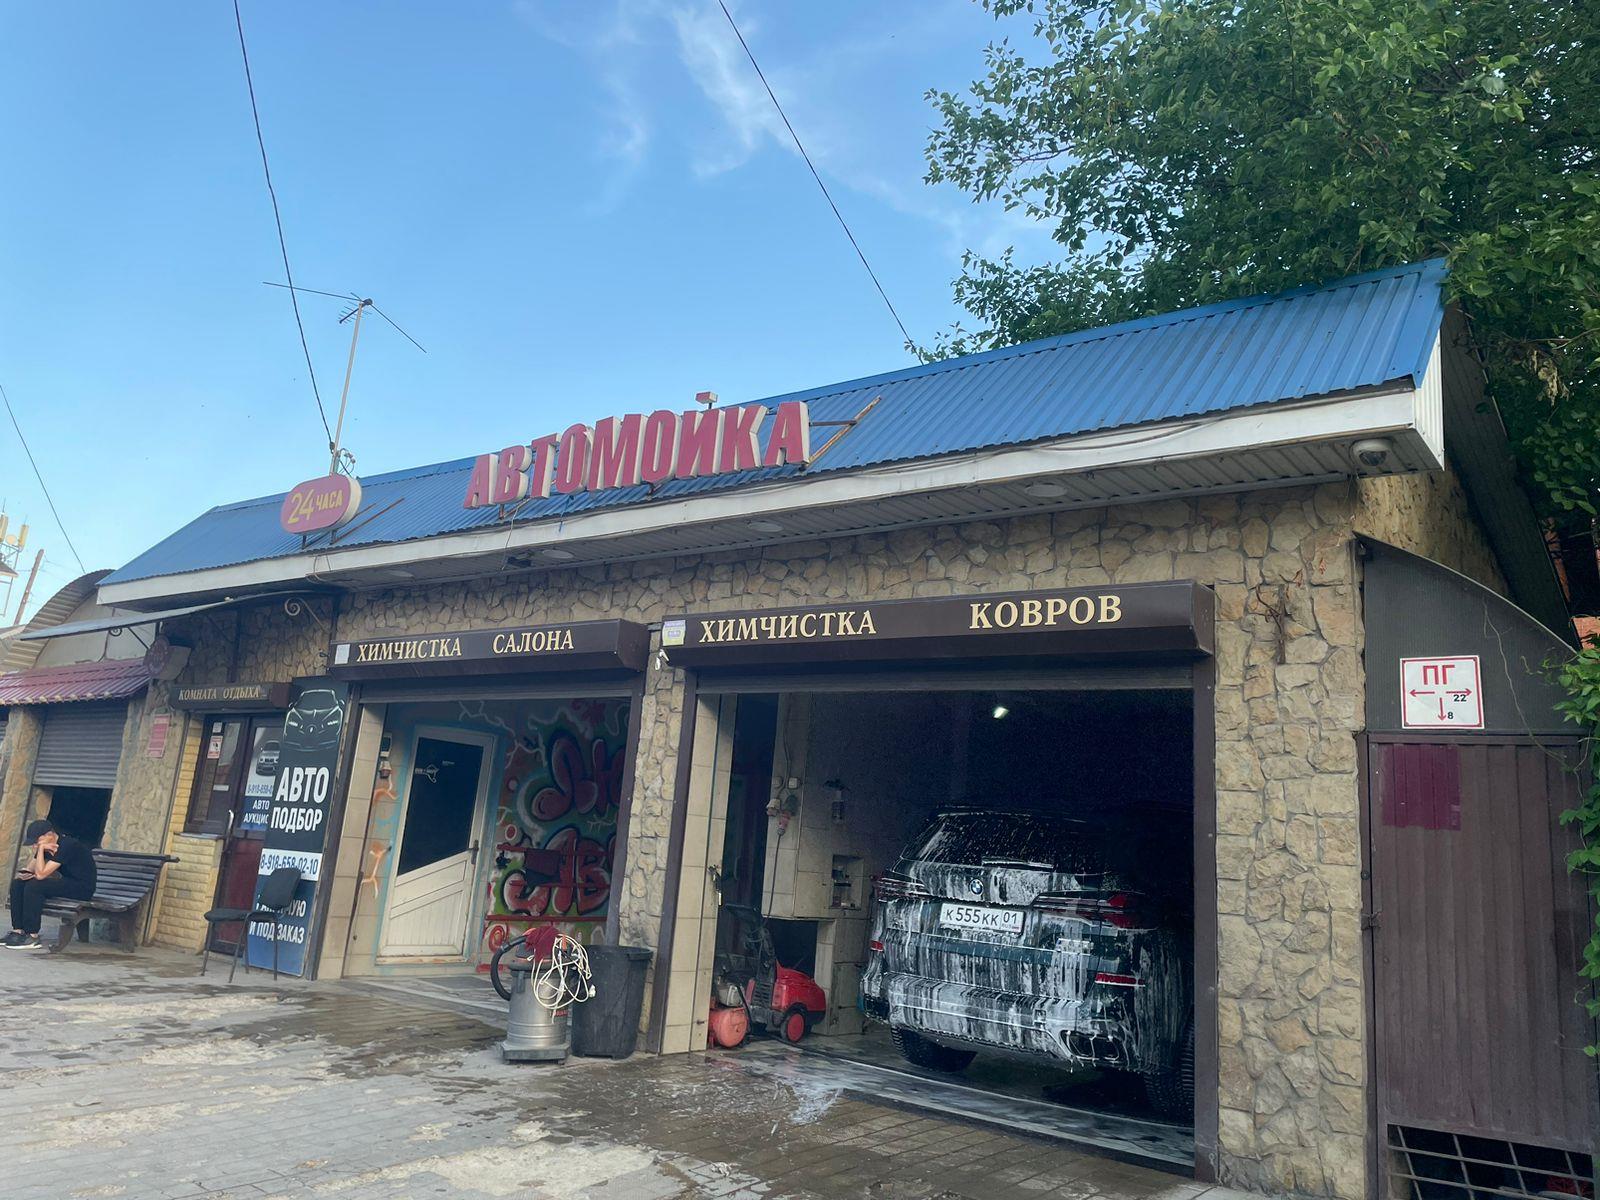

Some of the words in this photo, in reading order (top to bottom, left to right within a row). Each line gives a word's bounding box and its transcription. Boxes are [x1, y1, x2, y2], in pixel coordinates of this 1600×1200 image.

[463, 391, 810, 509] АВТОМОЙКА
[287, 489, 315, 524] 24
[316, 489, 343, 511] ЧАСА
[698, 610, 876, 643] ХИМЧИСТКА
[969, 595, 1122, 629] КОВРОВ
[356, 637, 462, 663] ХИМЧИСТКА
[492, 629, 574, 654] САЛОНА
[1423, 664, 1455, 685] ПГ
[178, 688, 217, 700] КОМНАТА
[223, 685, 260, 699] ОТДЫХА
[1453, 694, 1467, 702] 22
[275, 767, 330, 804] АВТО
[252, 799, 270, 810] АВТО
[270, 807, 323, 833] ПОДБОР
[1003, 911, 1017, 924] 01
[249, 921, 256, 935] И
[256, 922, 275, 941] ПОД
[277, 924, 305, 944] ЗАКАЗ
